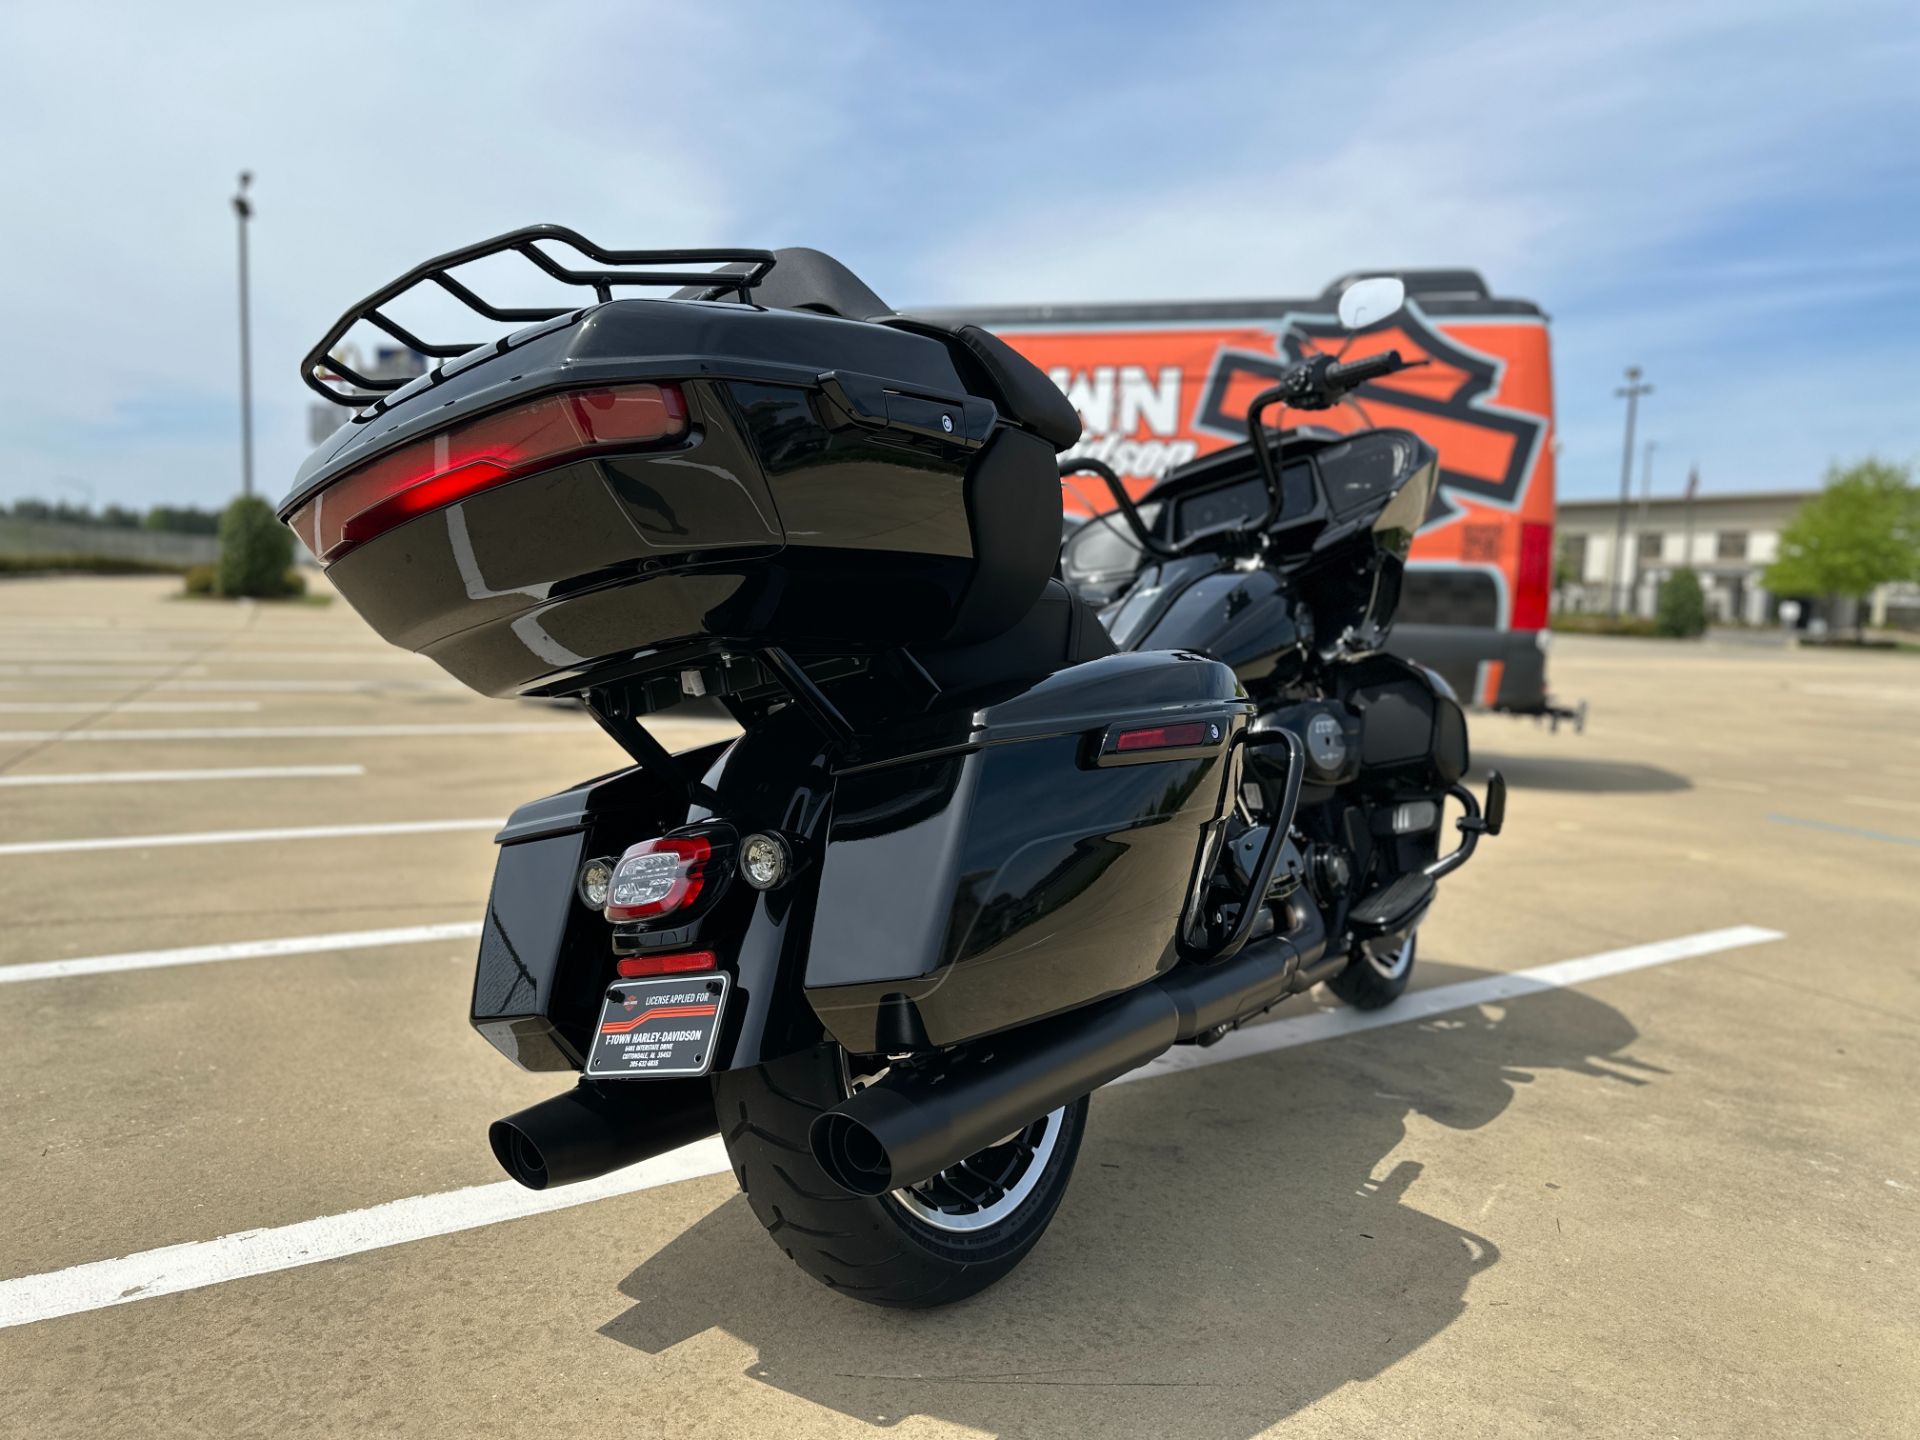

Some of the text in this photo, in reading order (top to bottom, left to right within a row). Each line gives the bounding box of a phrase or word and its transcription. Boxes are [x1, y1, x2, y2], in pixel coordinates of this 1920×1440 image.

[646, 995, 670, 1005] LICENSE
[670, 994, 694, 1004] APPLIED
[696, 993, 709, 1002] FOR
[606, 1030, 702, 1045] T-TOWN HARLEY-DAVIDSON
